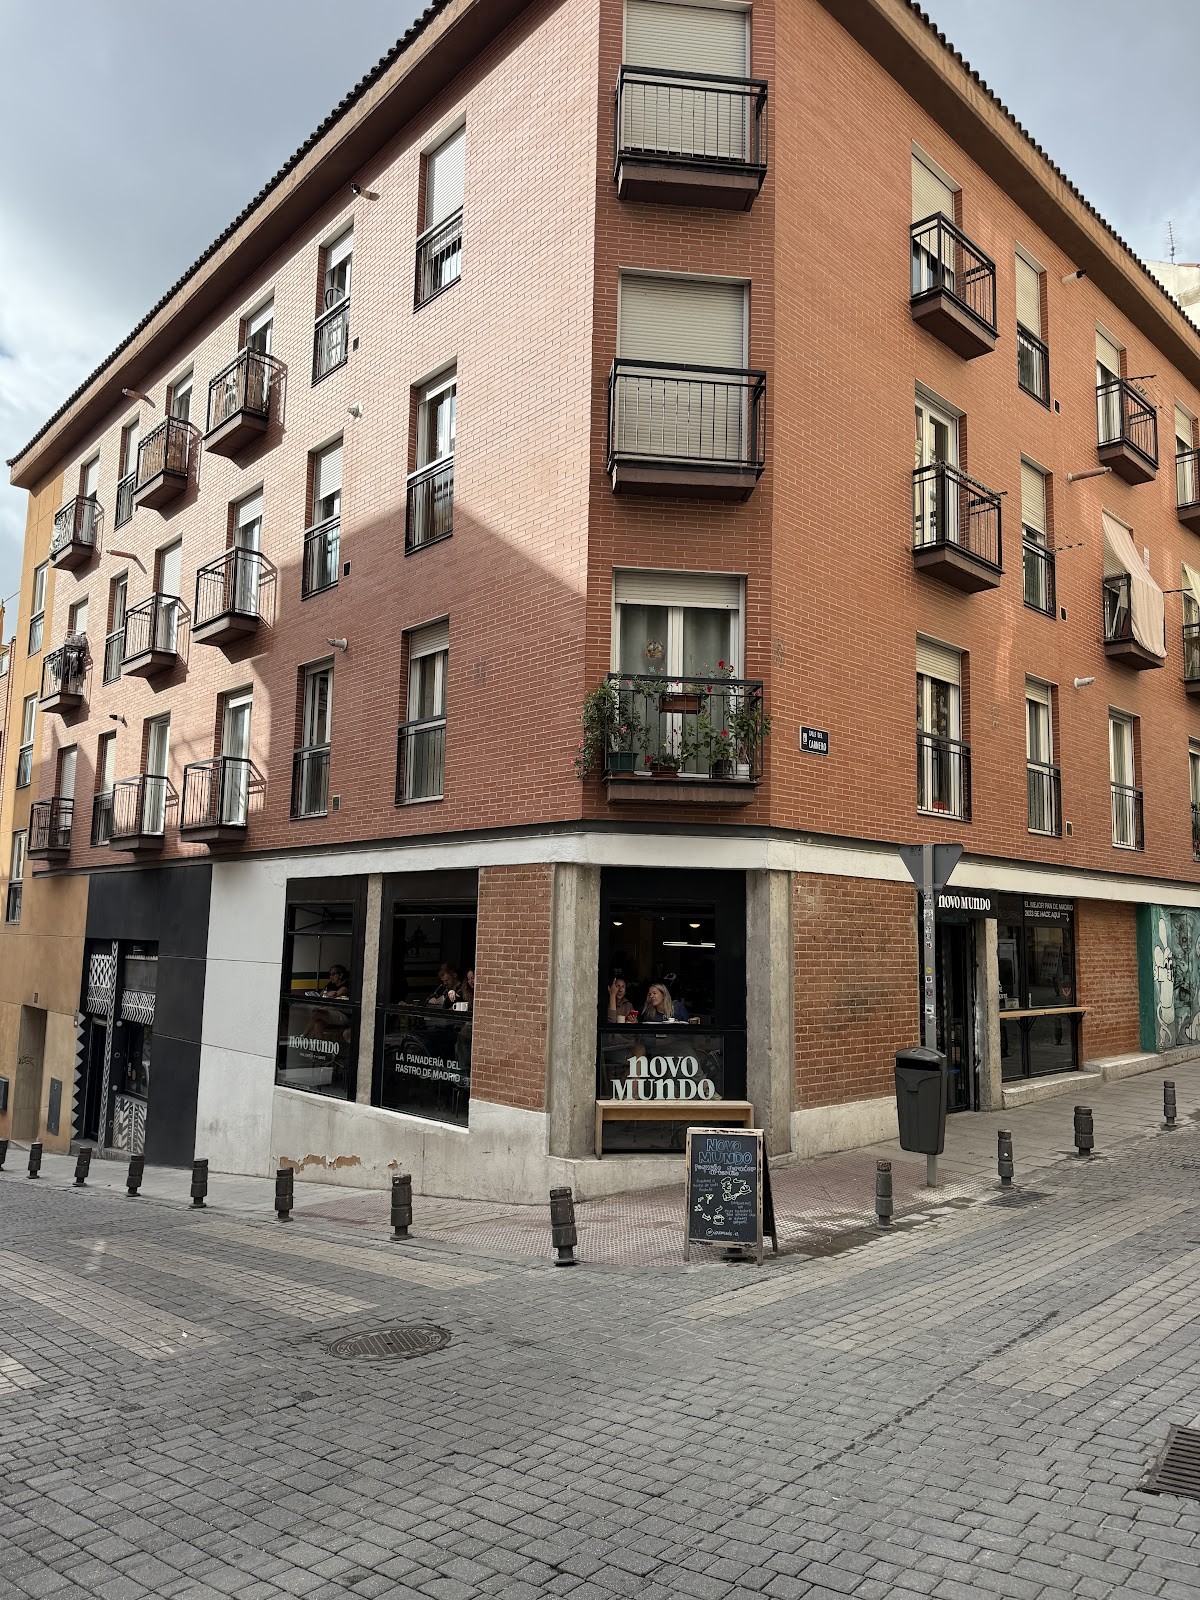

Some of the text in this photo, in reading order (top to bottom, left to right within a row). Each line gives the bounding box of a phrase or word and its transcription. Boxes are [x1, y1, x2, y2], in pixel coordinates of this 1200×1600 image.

[395, 1051, 460, 1070] LA PANADERÍA DEL
[395, 1063, 460, 1083] RASTRO DE MADRID
[706, 1138, 742, 1152] NOVO
[698, 1151, 753, 1165] MUNDO
